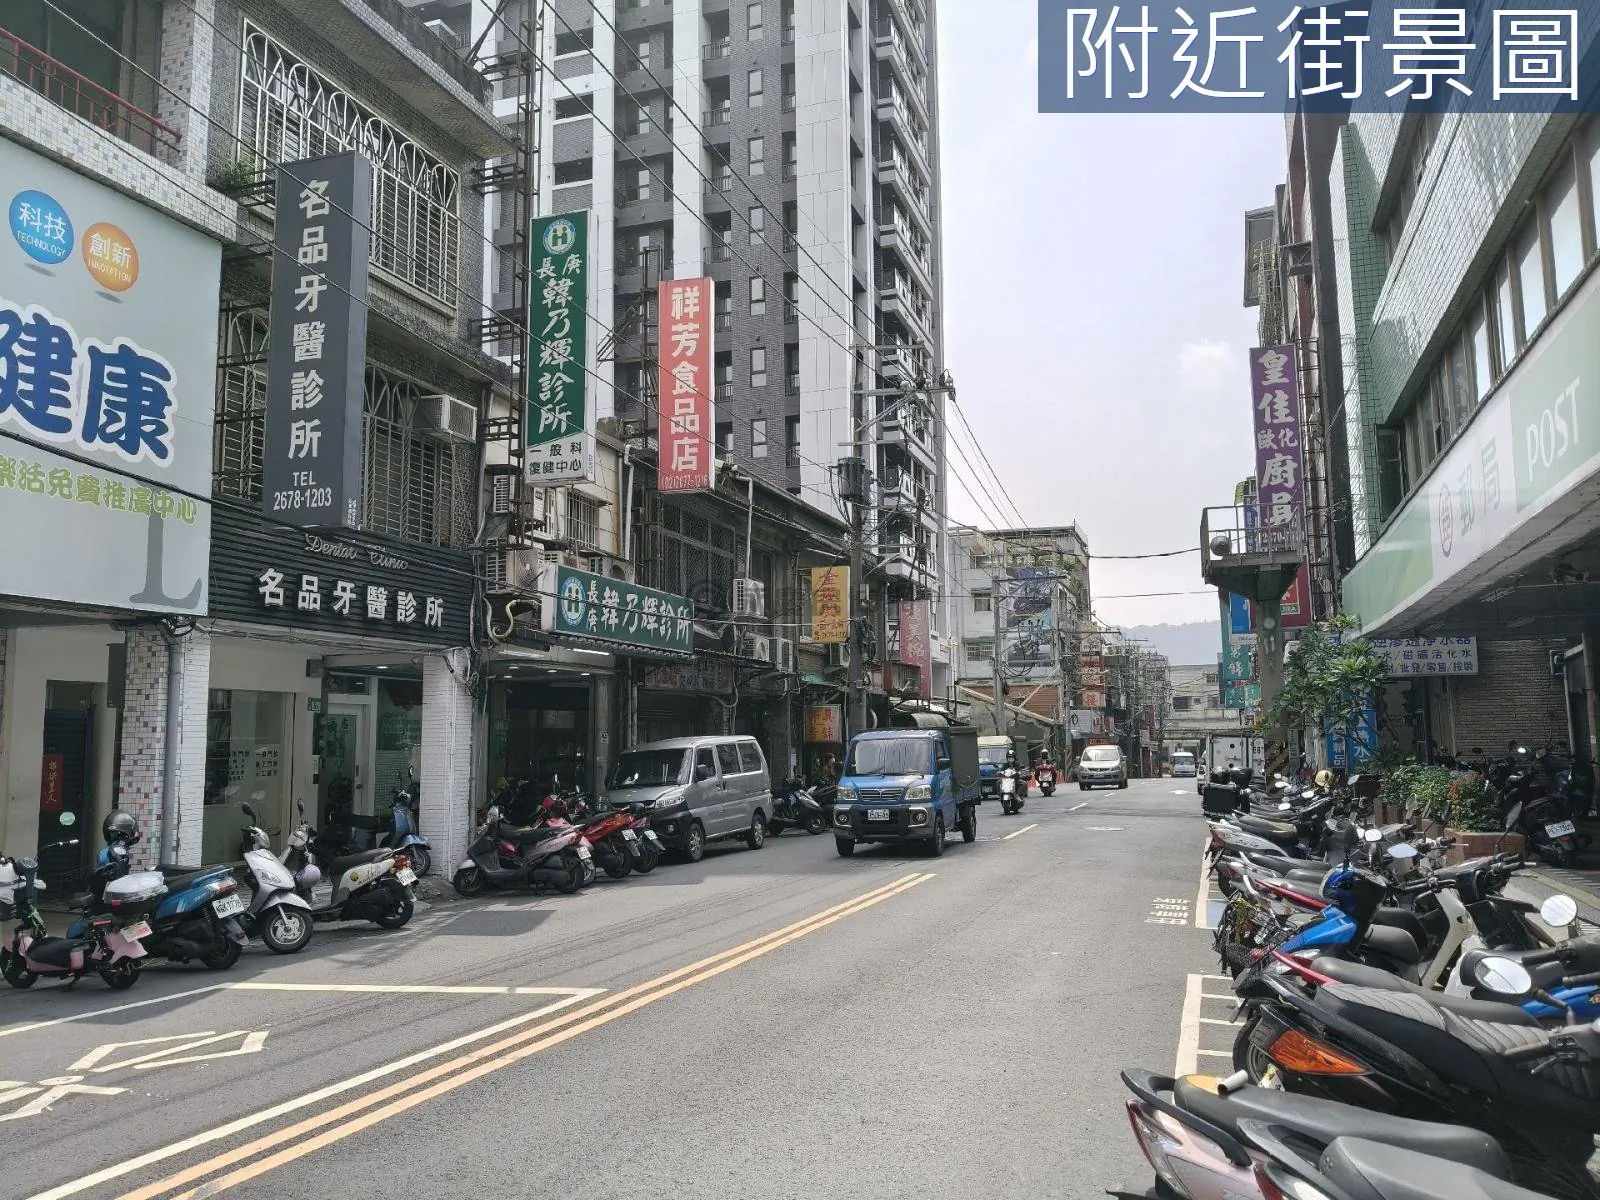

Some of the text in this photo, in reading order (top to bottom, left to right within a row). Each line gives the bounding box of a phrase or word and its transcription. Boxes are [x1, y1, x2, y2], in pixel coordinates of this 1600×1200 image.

[17, 231, 67, 257] TECHNOLOGY
[19, 202, 67, 244] 科技
[90, 233, 131, 269] 創新
[88, 259, 131, 283] INNOVATION
[288, 180, 331, 460] 名品牙醫診所
[0, 309, 173, 459] 健康
[538, 277, 575, 435] 韓乃輝診所
[670, 286, 700, 471] 祥芳食品店
[1258, 349, 1295, 425] 皇佳
[529, 441, 582, 457] 一般科
[1526, 375, 1581, 483] POST
[0, 455, 199, 525] 樂活免費推廣中心
[292, 471, 317, 487] TEL
[529, 458, 582, 476] 復健中心
[1458, 437, 1501, 537] 郵局
[272, 487, 332, 511] 2678-1203
[258, 567, 444, 628] 名品牙醫診所
[601, 585, 692, 645] 韓乃輝診所
